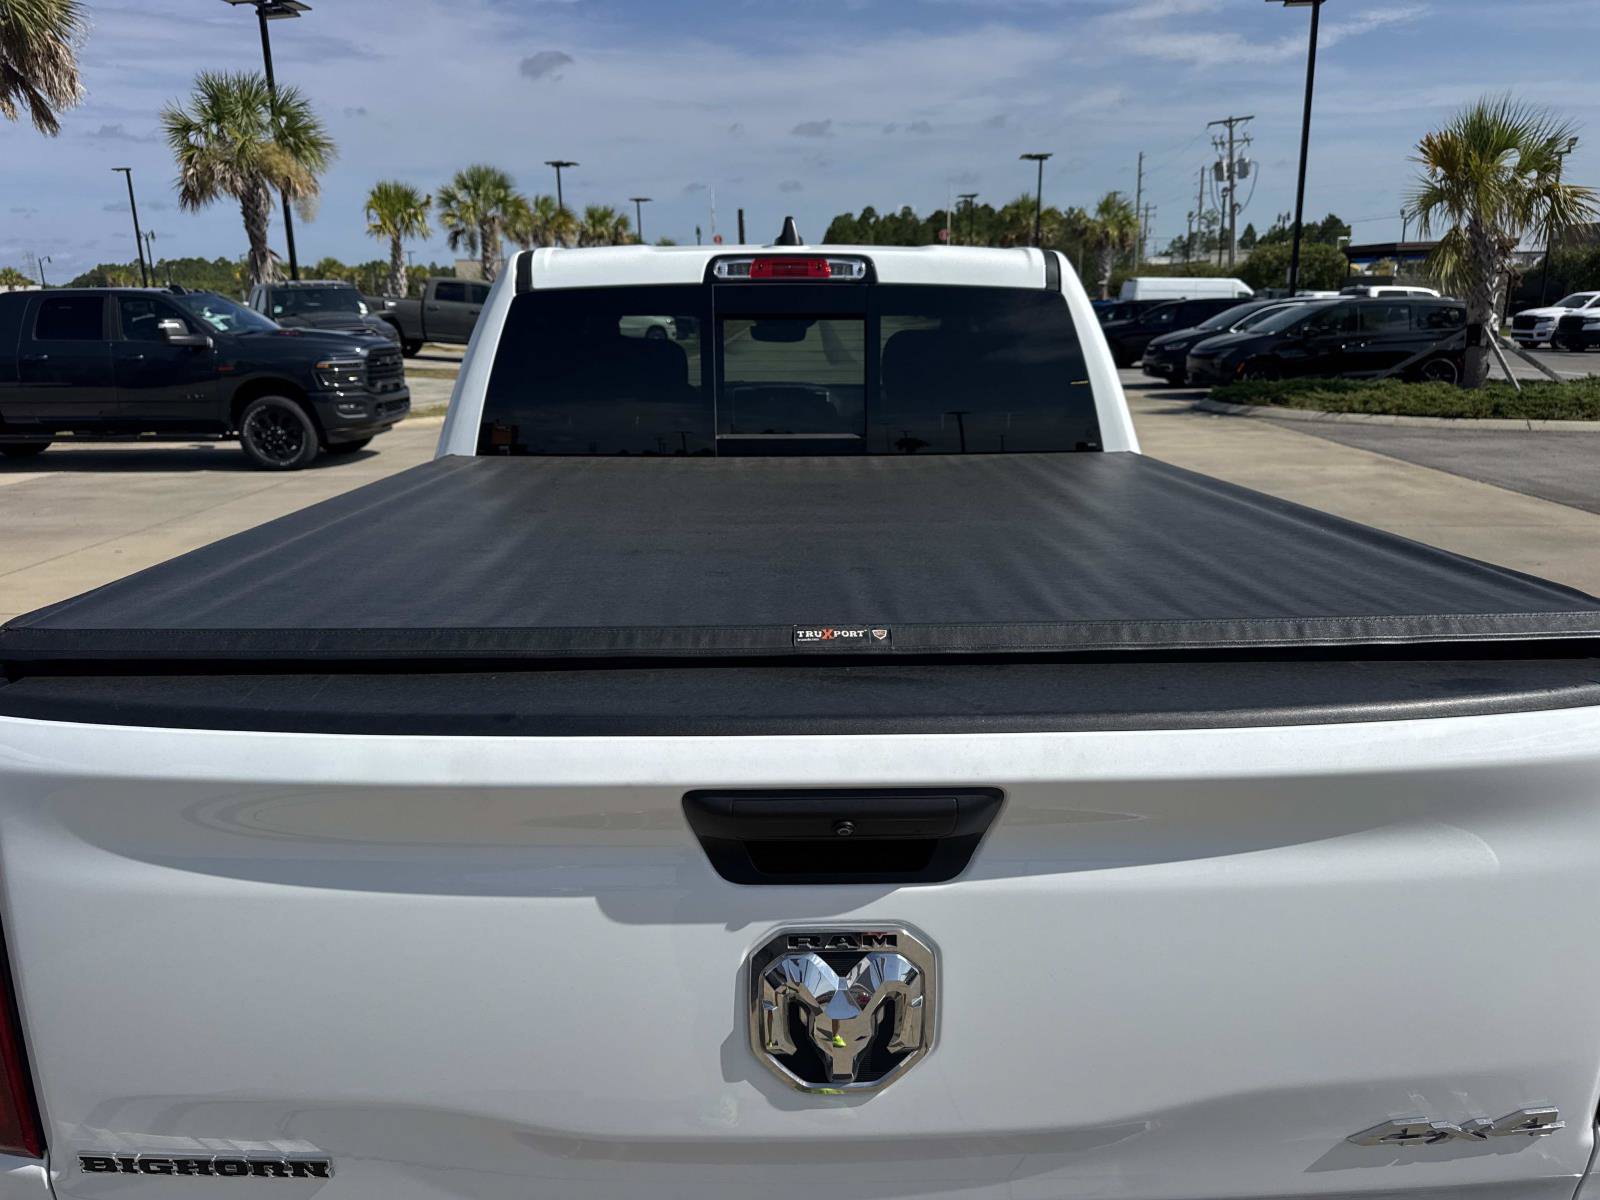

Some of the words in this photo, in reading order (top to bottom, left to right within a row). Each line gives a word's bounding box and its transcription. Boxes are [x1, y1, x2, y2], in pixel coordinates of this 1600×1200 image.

[797, 628, 865, 640] TRUXPORT
[787, 934, 898, 949] RAM
[78, 1153, 334, 1178] BIGHORN
